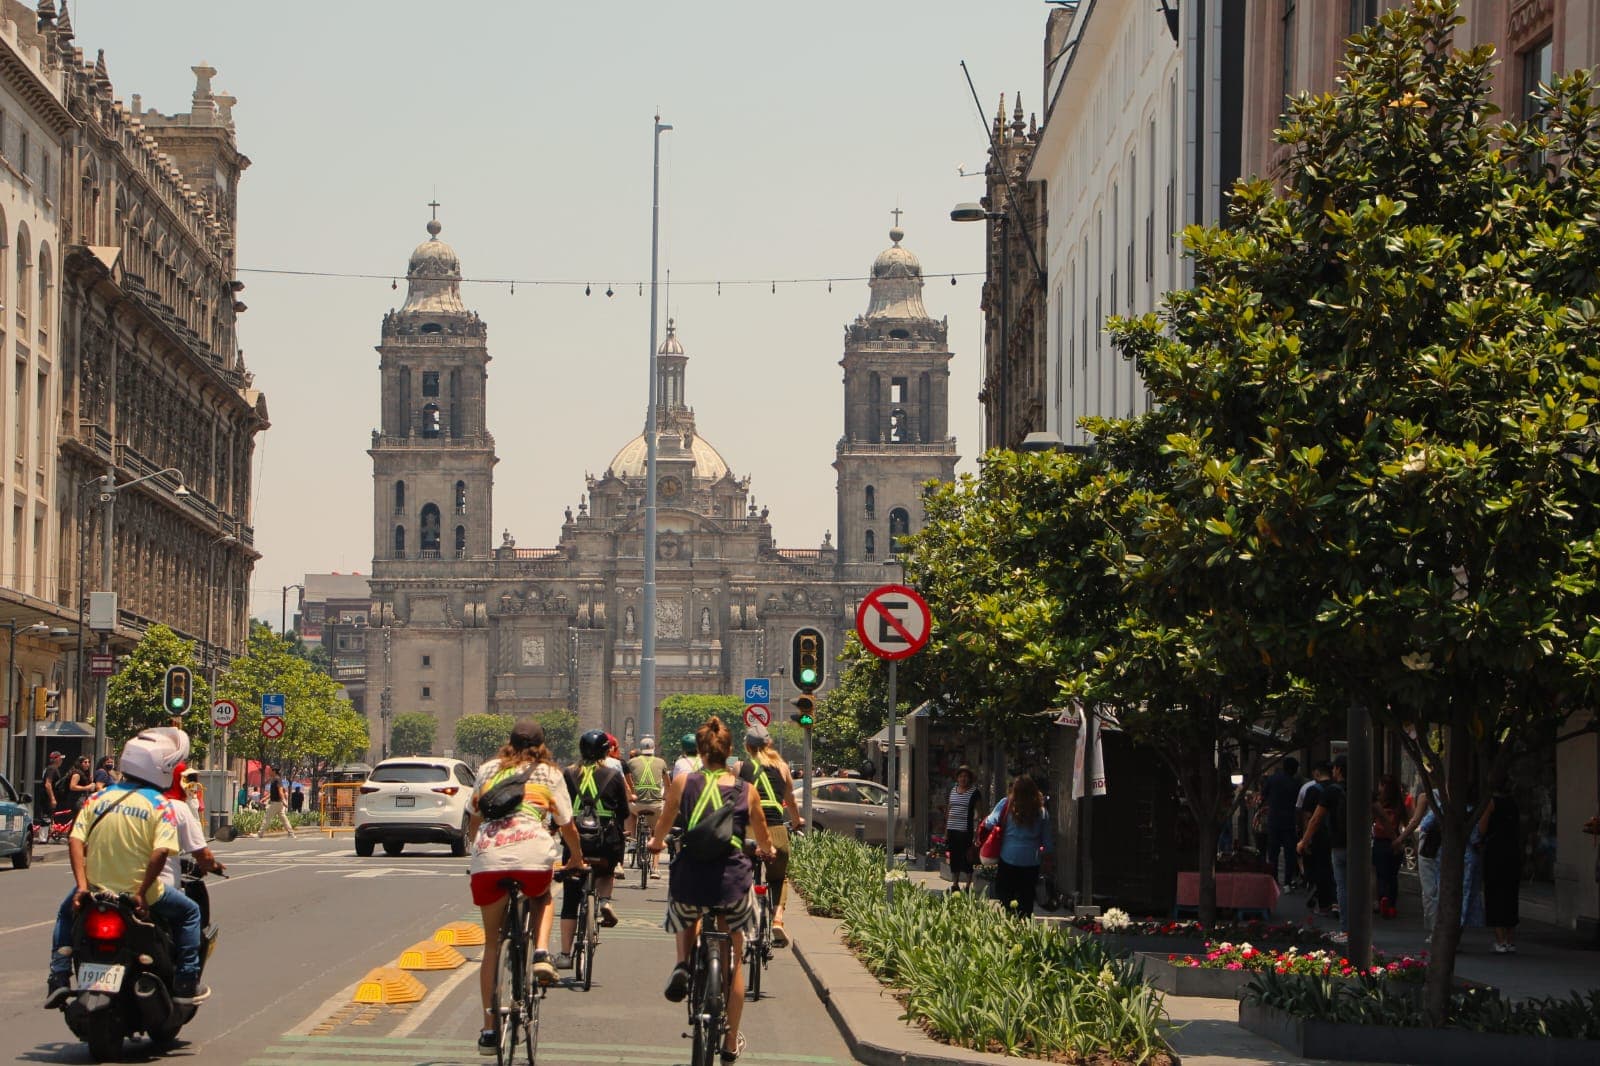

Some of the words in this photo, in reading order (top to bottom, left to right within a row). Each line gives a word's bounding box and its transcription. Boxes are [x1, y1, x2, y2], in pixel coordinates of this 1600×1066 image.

[879, 602, 909, 643] E
[216, 706, 231, 715] 40
[83, 971, 117, 985] 1910C1
